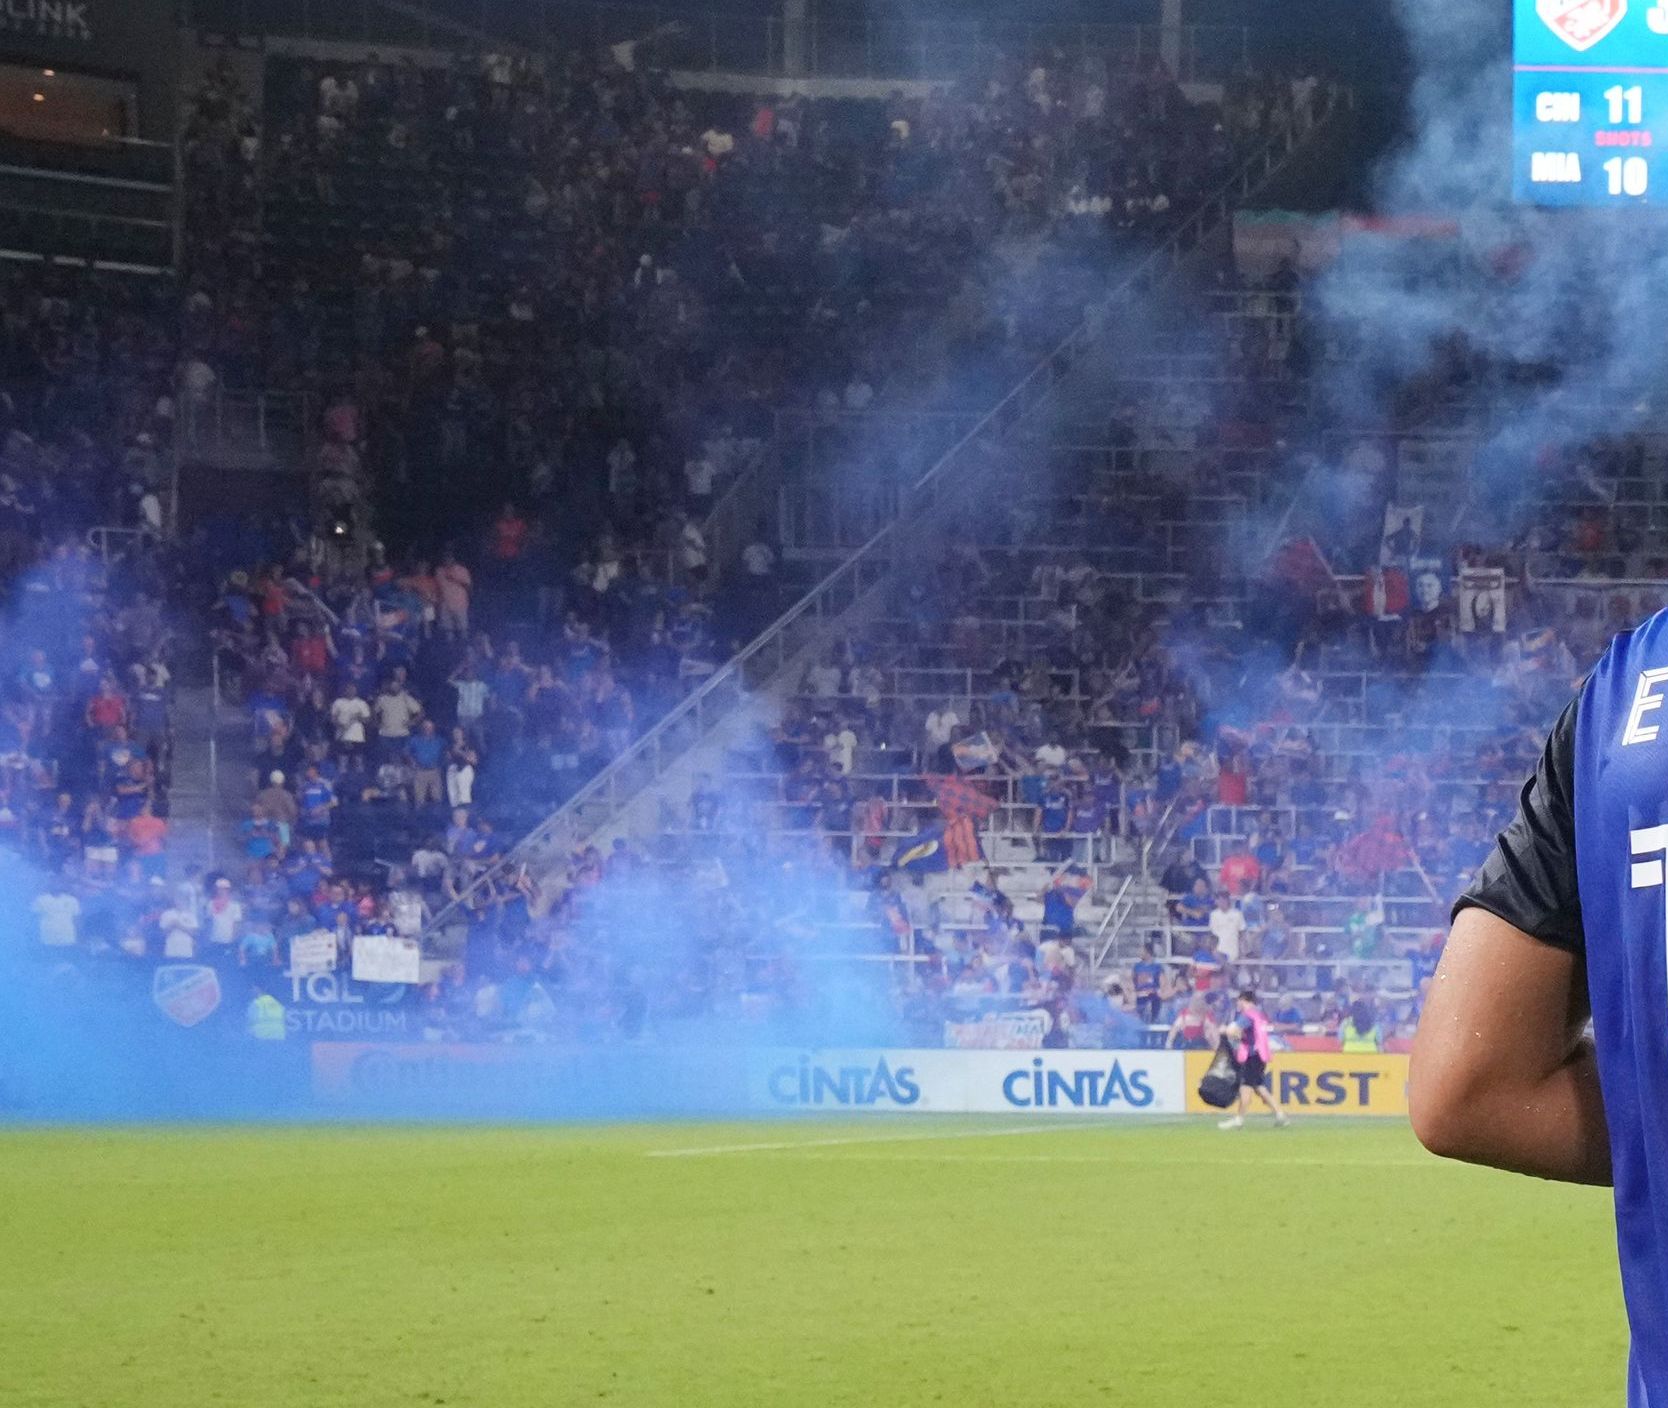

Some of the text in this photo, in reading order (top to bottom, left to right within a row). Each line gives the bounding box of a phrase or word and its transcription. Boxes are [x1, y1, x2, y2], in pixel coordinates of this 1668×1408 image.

[1603, 85, 1642, 124] 11
[1531, 152, 1582, 182] MIA
[1603, 156, 1648, 196] 10
[283, 969, 364, 1003] TQL
[286, 1009, 407, 1033] STADIUM
